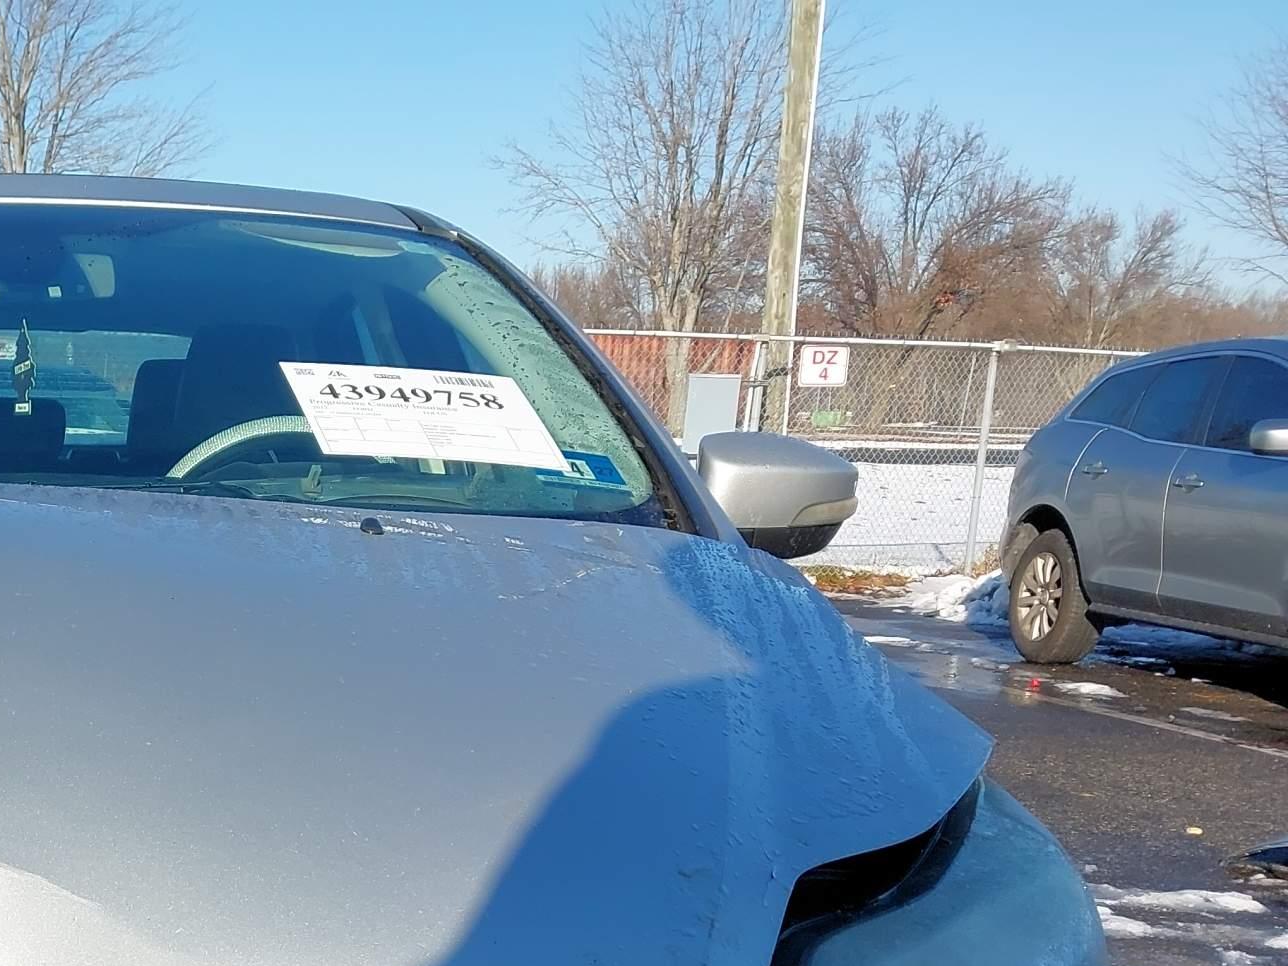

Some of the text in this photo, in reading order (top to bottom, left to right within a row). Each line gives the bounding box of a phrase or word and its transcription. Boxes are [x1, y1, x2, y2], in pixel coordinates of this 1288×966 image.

[812, 350, 840, 365] DZ
[818, 367, 829, 381] 4
[319, 383, 505, 410] 43949758
